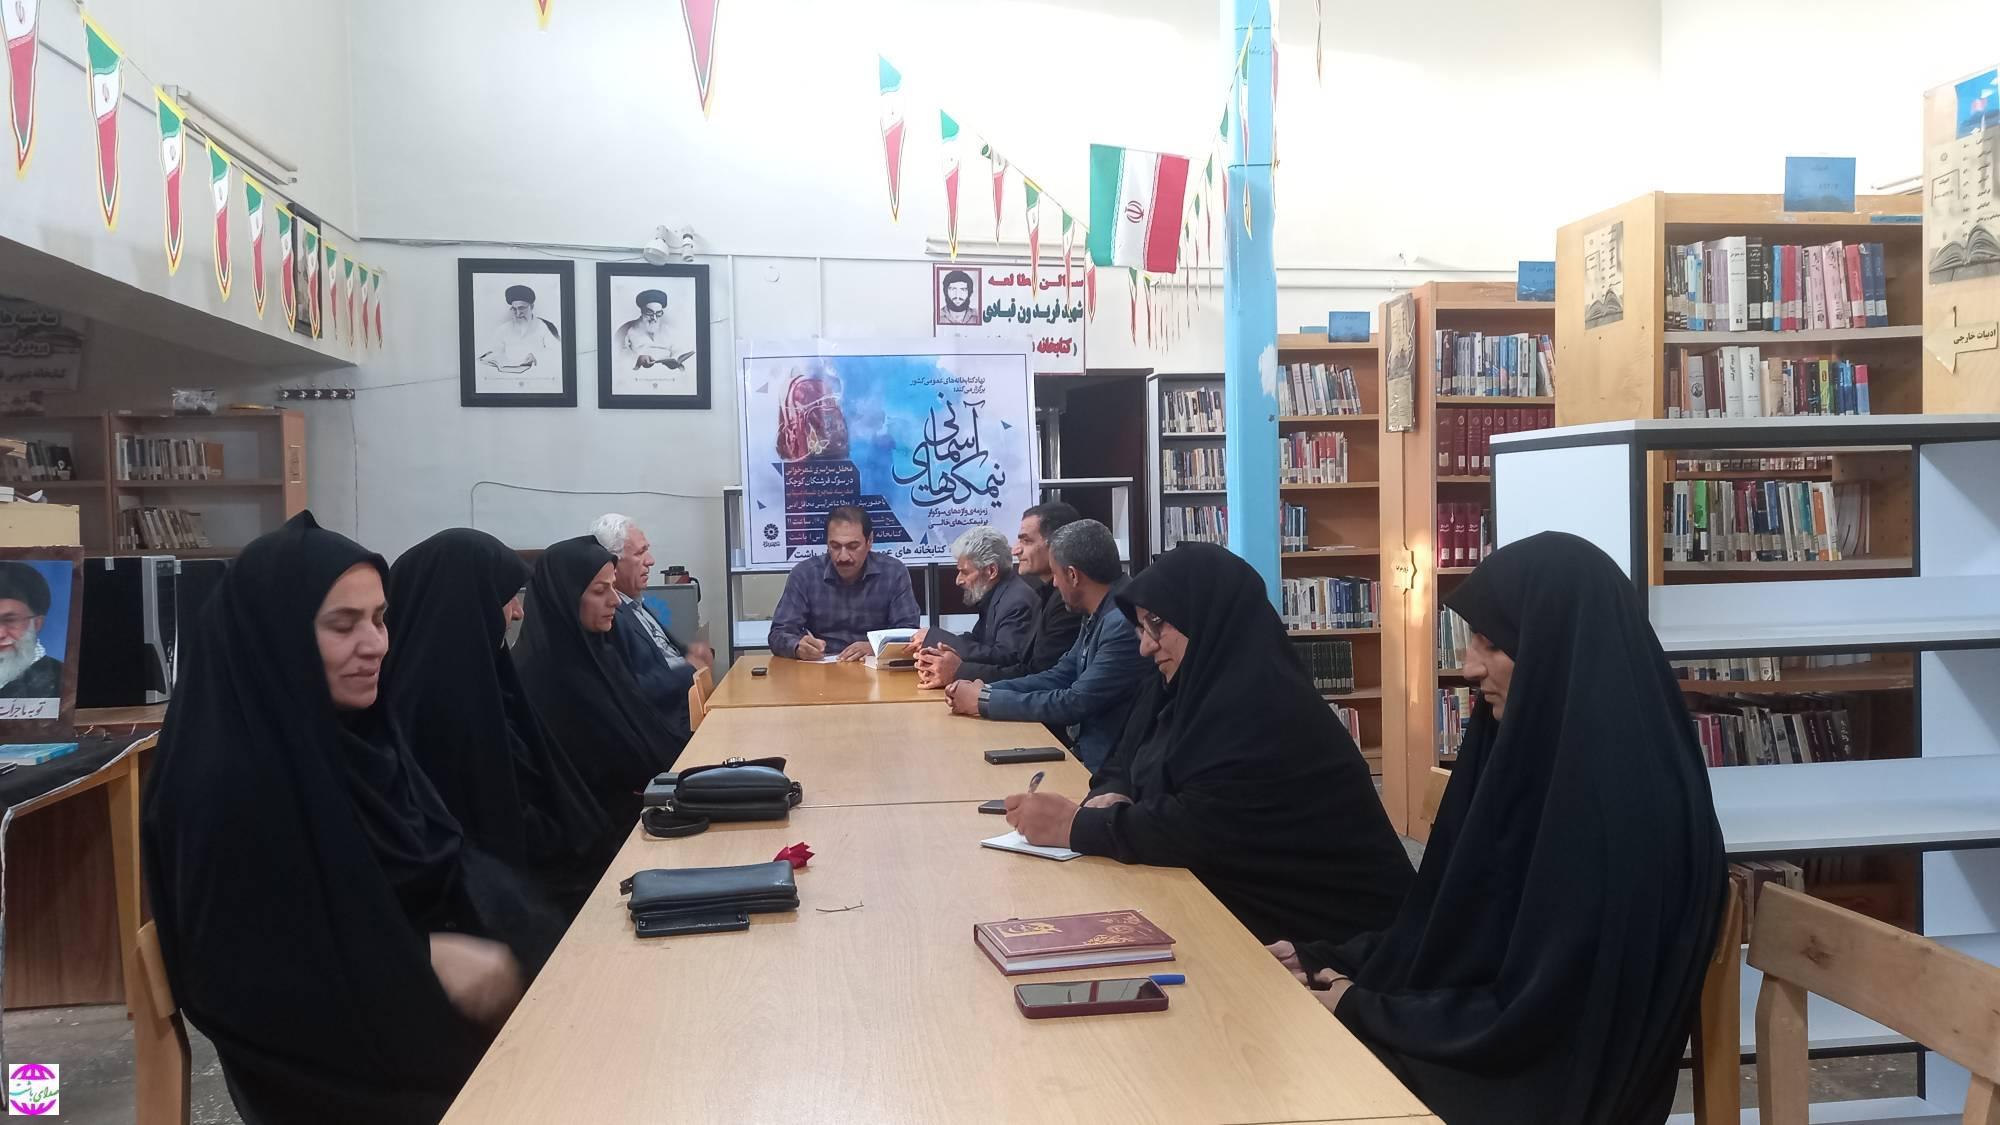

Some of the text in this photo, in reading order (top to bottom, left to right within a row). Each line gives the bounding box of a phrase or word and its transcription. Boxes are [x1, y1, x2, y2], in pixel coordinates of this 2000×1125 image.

[988, 273, 1036, 287] طالعه
[983, 298, 1016, 323] قبادی
[1062, 300, 1083, 323] شهید
[1953, 328, 1997, 345] ادبیات خارجی
[923, 378, 943, 386] عمومی
[974, 376, 986, 385] نهاد
[834, 465, 854, 474] محفل
[785, 478, 805, 488] کوچک
[804, 477, 831, 487] فرشتگان
[830, 475, 846, 486] سوگ
[928, 508, 947, 518] سوگوار
[875, 529, 902, 539] کتابخانه
[895, 546, 912, 558] های
[914, 545, 947, 557] کتابخانه
